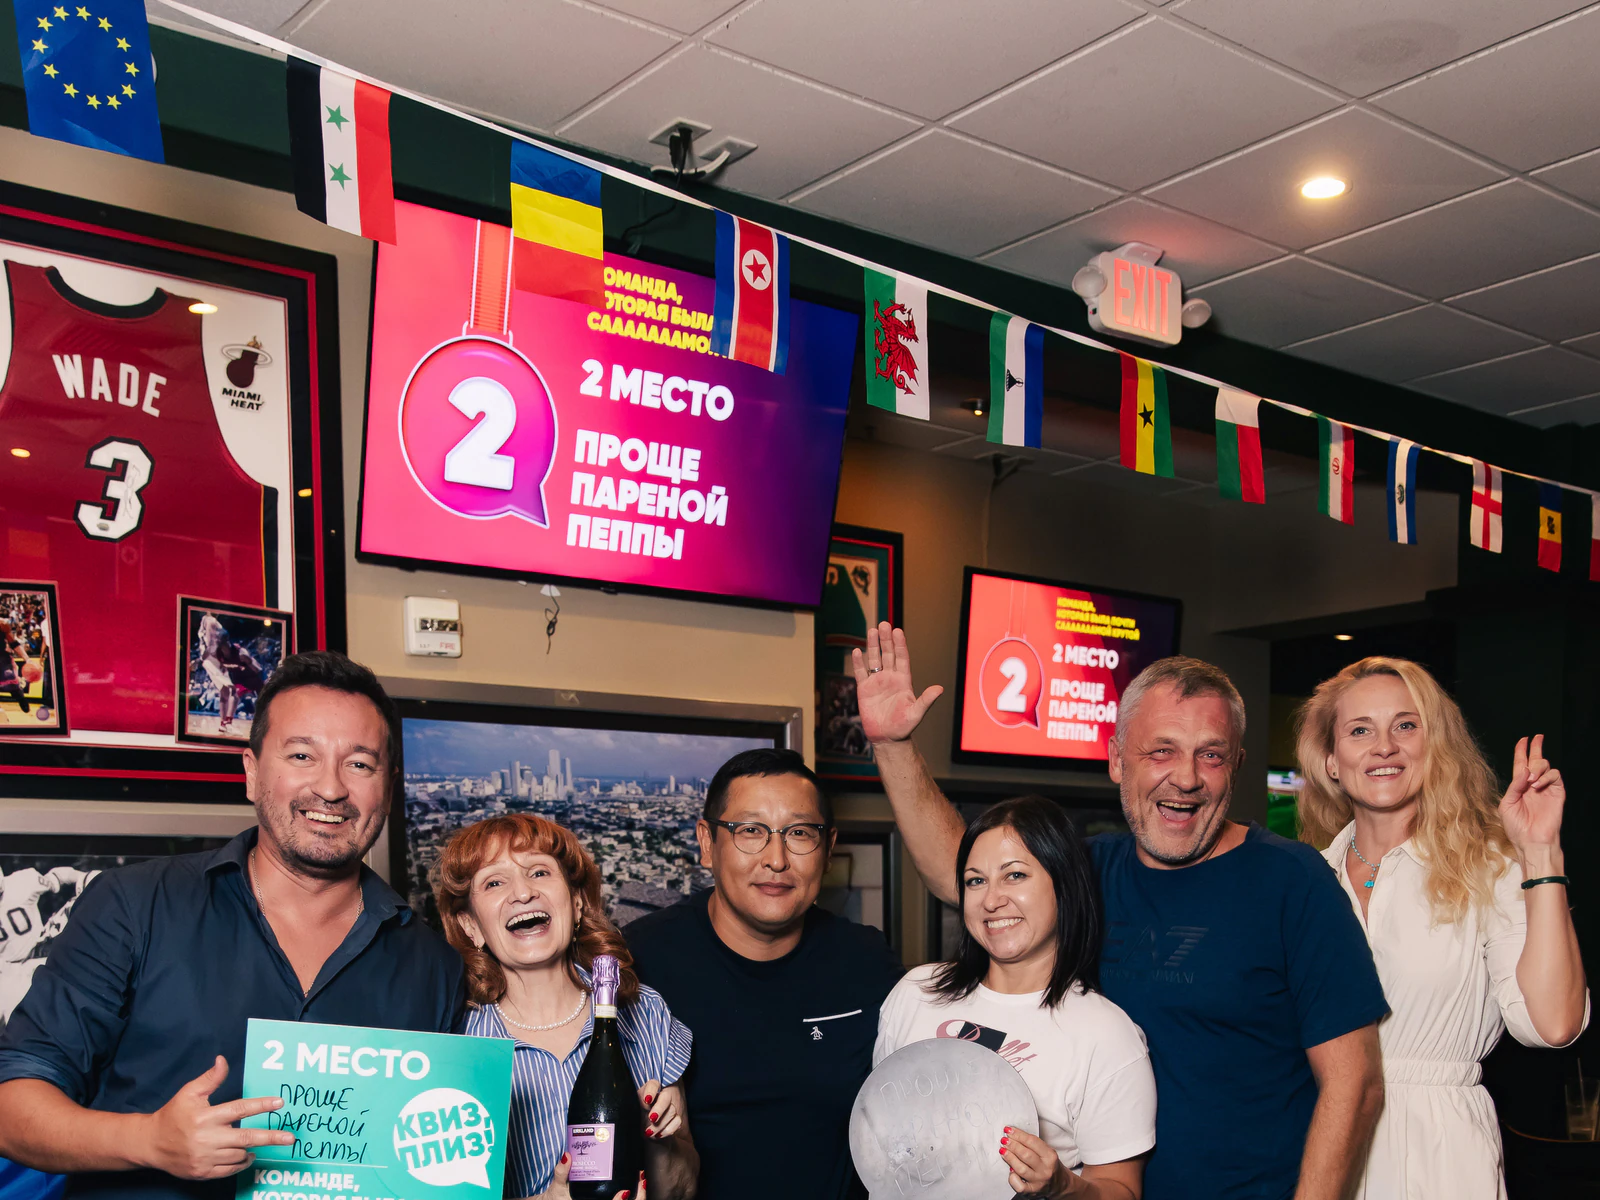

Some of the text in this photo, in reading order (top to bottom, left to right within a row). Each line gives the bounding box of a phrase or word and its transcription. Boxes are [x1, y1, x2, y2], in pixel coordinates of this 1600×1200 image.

[603, 267, 684, 305] ОМАНДА,
[604, 290, 669, 321] ОТОРАЯ
[1114, 258, 1172, 337] EXIT
[587, 311, 713, 356] САААААААМО
[52, 353, 167, 418] WADE
[222, 387, 261, 402] MIAMI
[230, 399, 264, 411] HEAT
[580, 358, 735, 421] 2 МЕСТО
[444, 376, 517, 491] 2
[574, 429, 702, 484] ПРОЩЕ
[75, 437, 154, 541] 3
[570, 472, 729, 527] ПАРЕНОЙ
[566, 513, 685, 561] ПЕППЫ
[1052, 643, 1119, 670] 2 МЕСТО
[997, 657, 1027, 713] 2
[1050, 679, 1105, 702] ПРОЩЕ
[1046, 720, 1098, 742] ПЕППЫ
[1048, 700, 1117, 724] ПАРЕНОЙ
[262, 1040, 431, 1080] 2 МЕСТО
[280, 1084, 354, 1112] ПРОЩЕ
[254, 1169, 360, 1192] КОМАНДЕ,
